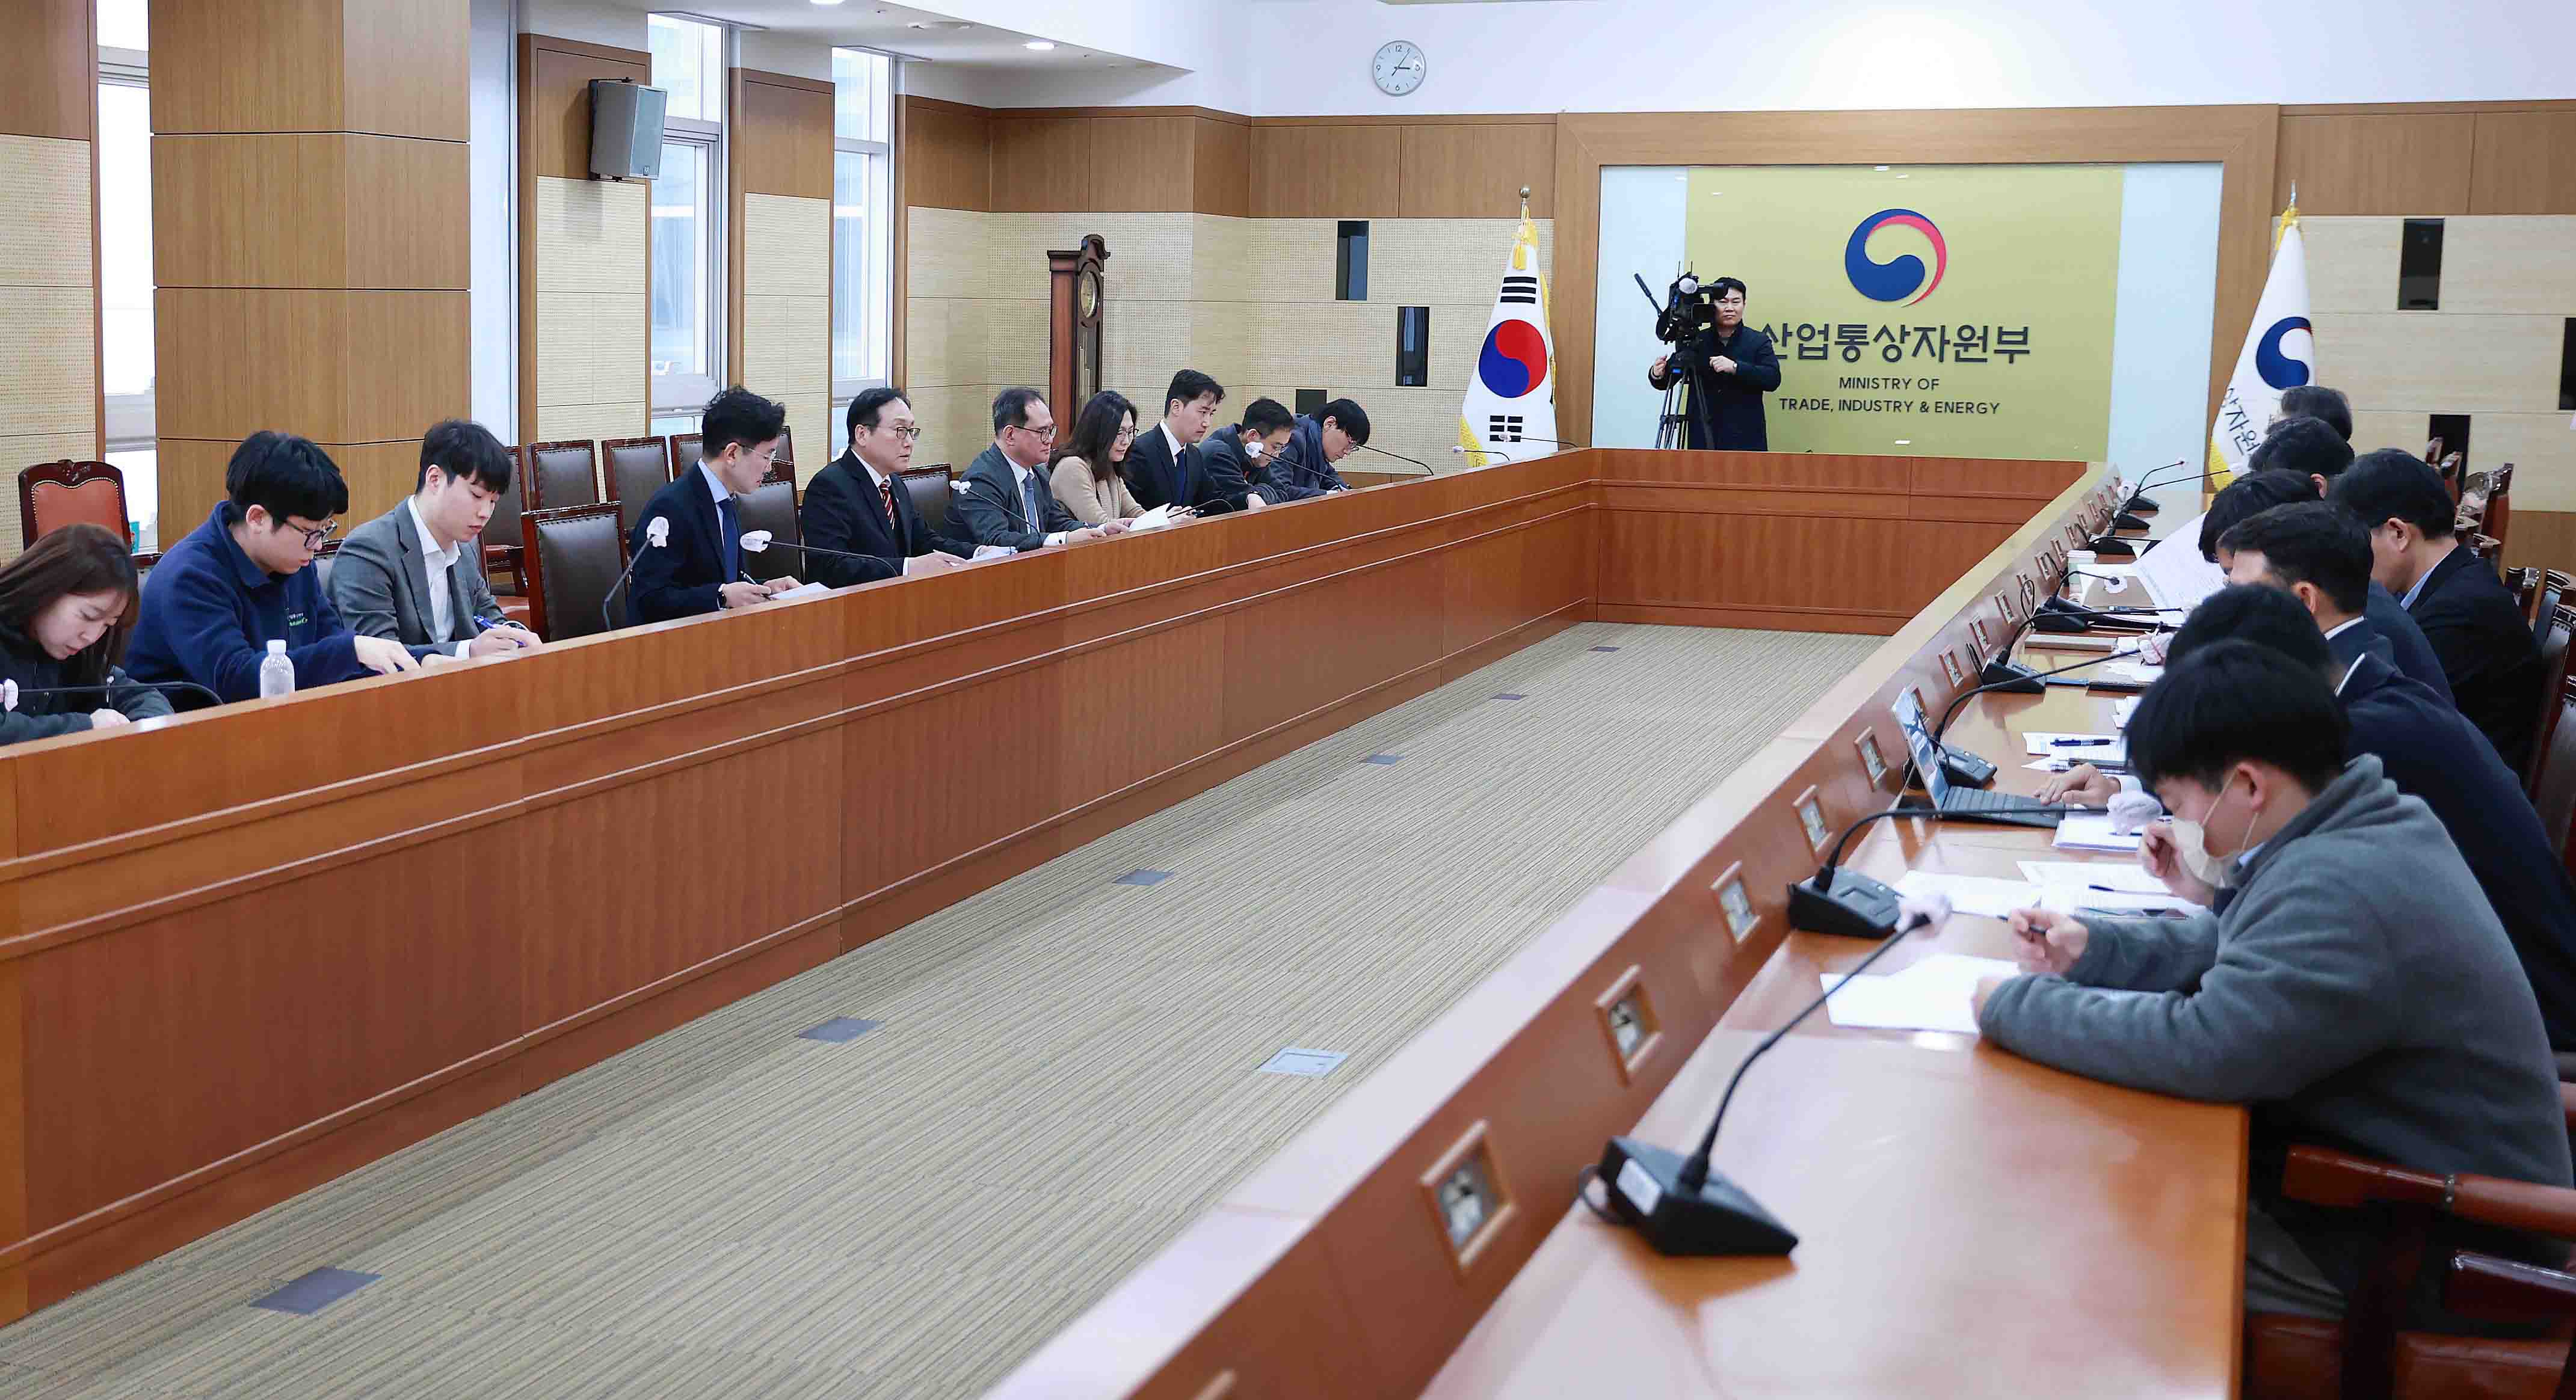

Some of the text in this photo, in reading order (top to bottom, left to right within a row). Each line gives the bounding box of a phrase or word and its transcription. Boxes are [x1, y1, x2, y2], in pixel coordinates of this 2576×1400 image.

[1395, 82, 1400, 91] 6
[1838, 376, 1940, 390] MINISTRY OF
[1779, 398, 2000, 414] TRADE, INDUSTRY & ENERGY
